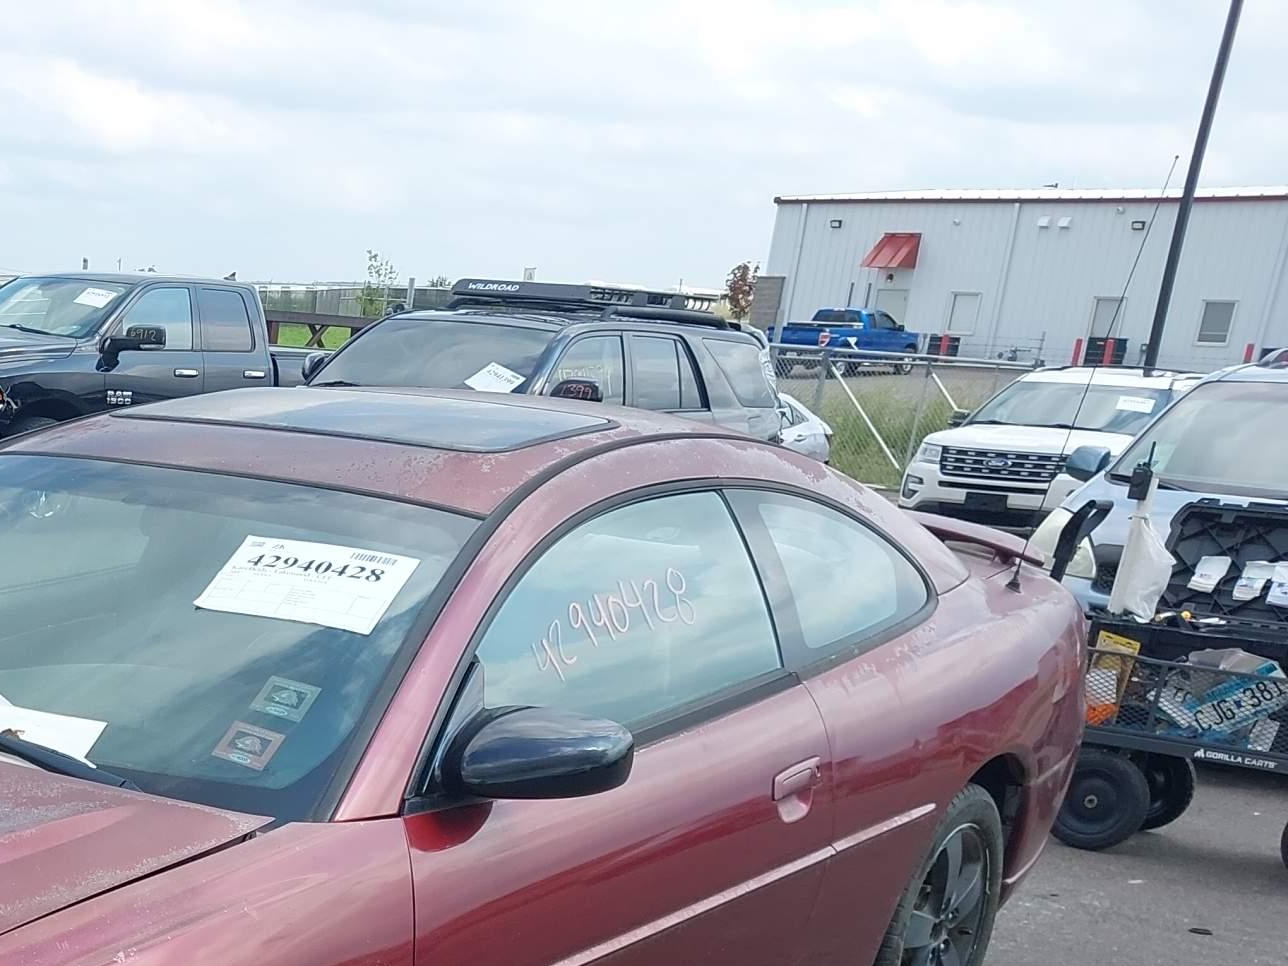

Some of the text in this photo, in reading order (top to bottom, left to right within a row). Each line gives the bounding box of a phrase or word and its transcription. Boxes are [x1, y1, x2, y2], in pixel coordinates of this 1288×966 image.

[468, 282, 520, 292] WILDROAD
[247, 553, 386, 583] 42940428
[530, 567, 696, 682] 42940428
[1193, 699, 1236, 731] CJG
[1206, 750, 1276, 769] GORILLA CARTS
